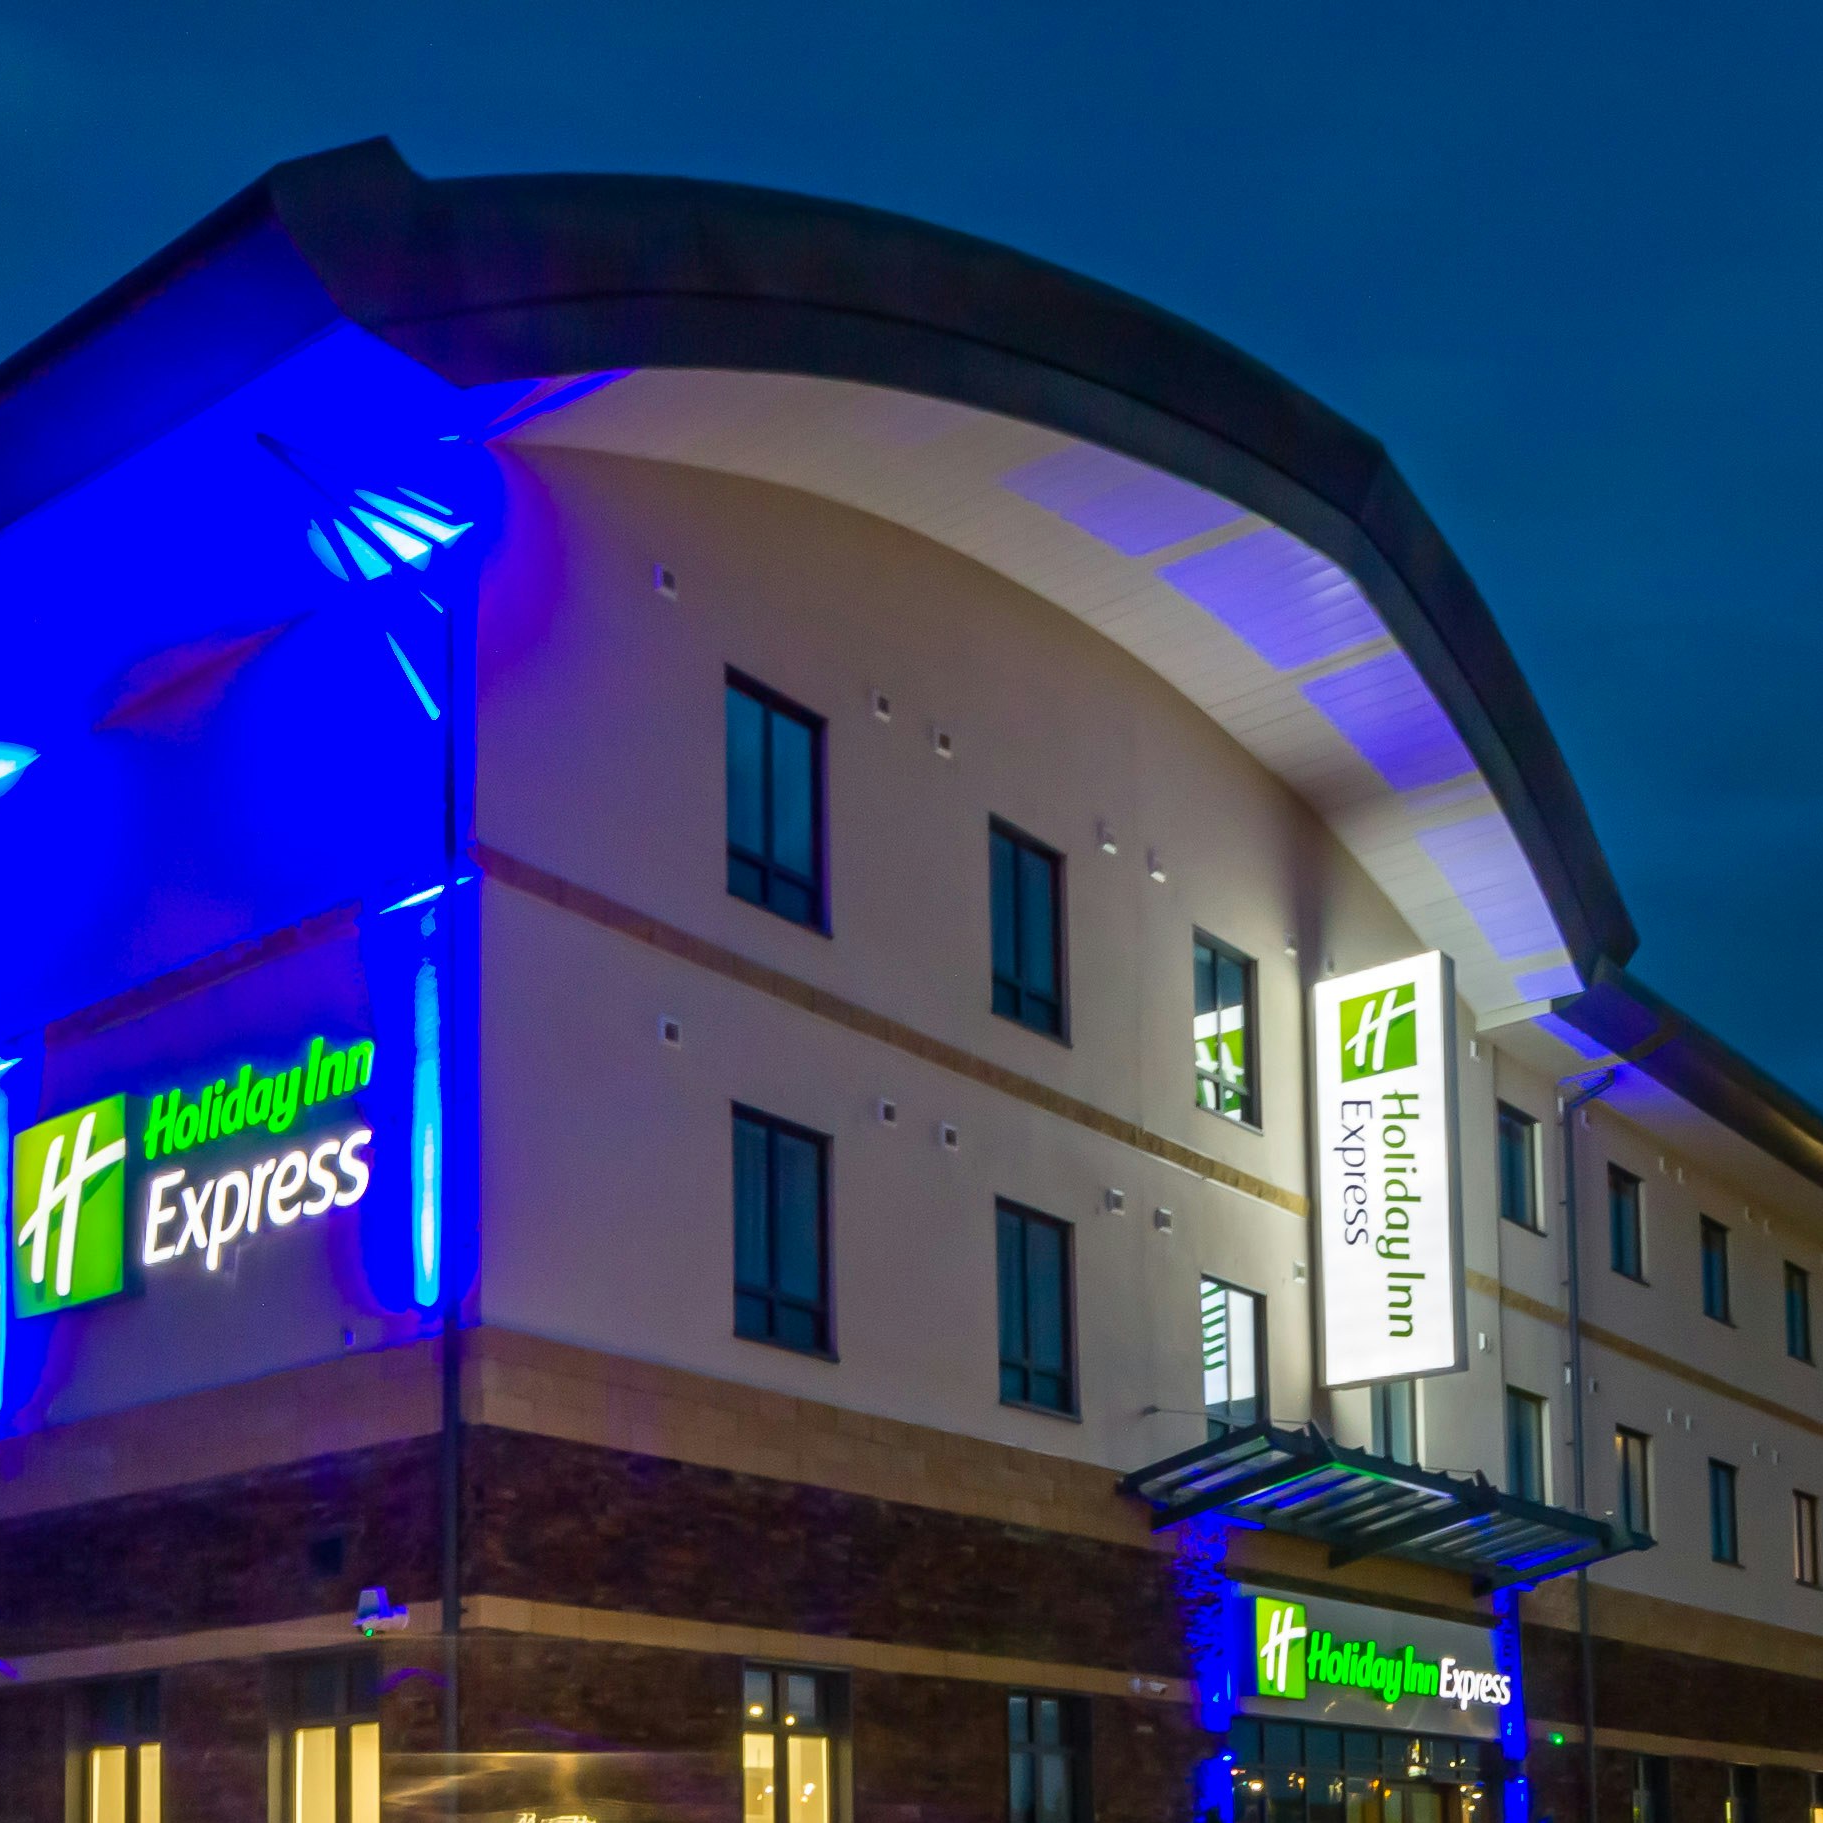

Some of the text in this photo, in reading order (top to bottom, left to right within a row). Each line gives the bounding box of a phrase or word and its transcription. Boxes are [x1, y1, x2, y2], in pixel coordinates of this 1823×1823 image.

[145, 1035, 375, 1160] Holiday Inn
[143, 1129, 372, 1272] Express
[1333, 1100, 1374, 1246] Express
[1376, 1089, 1426, 1338] Holiday Inn
[1307, 1631, 1512, 1711] Holiday Inn Express
